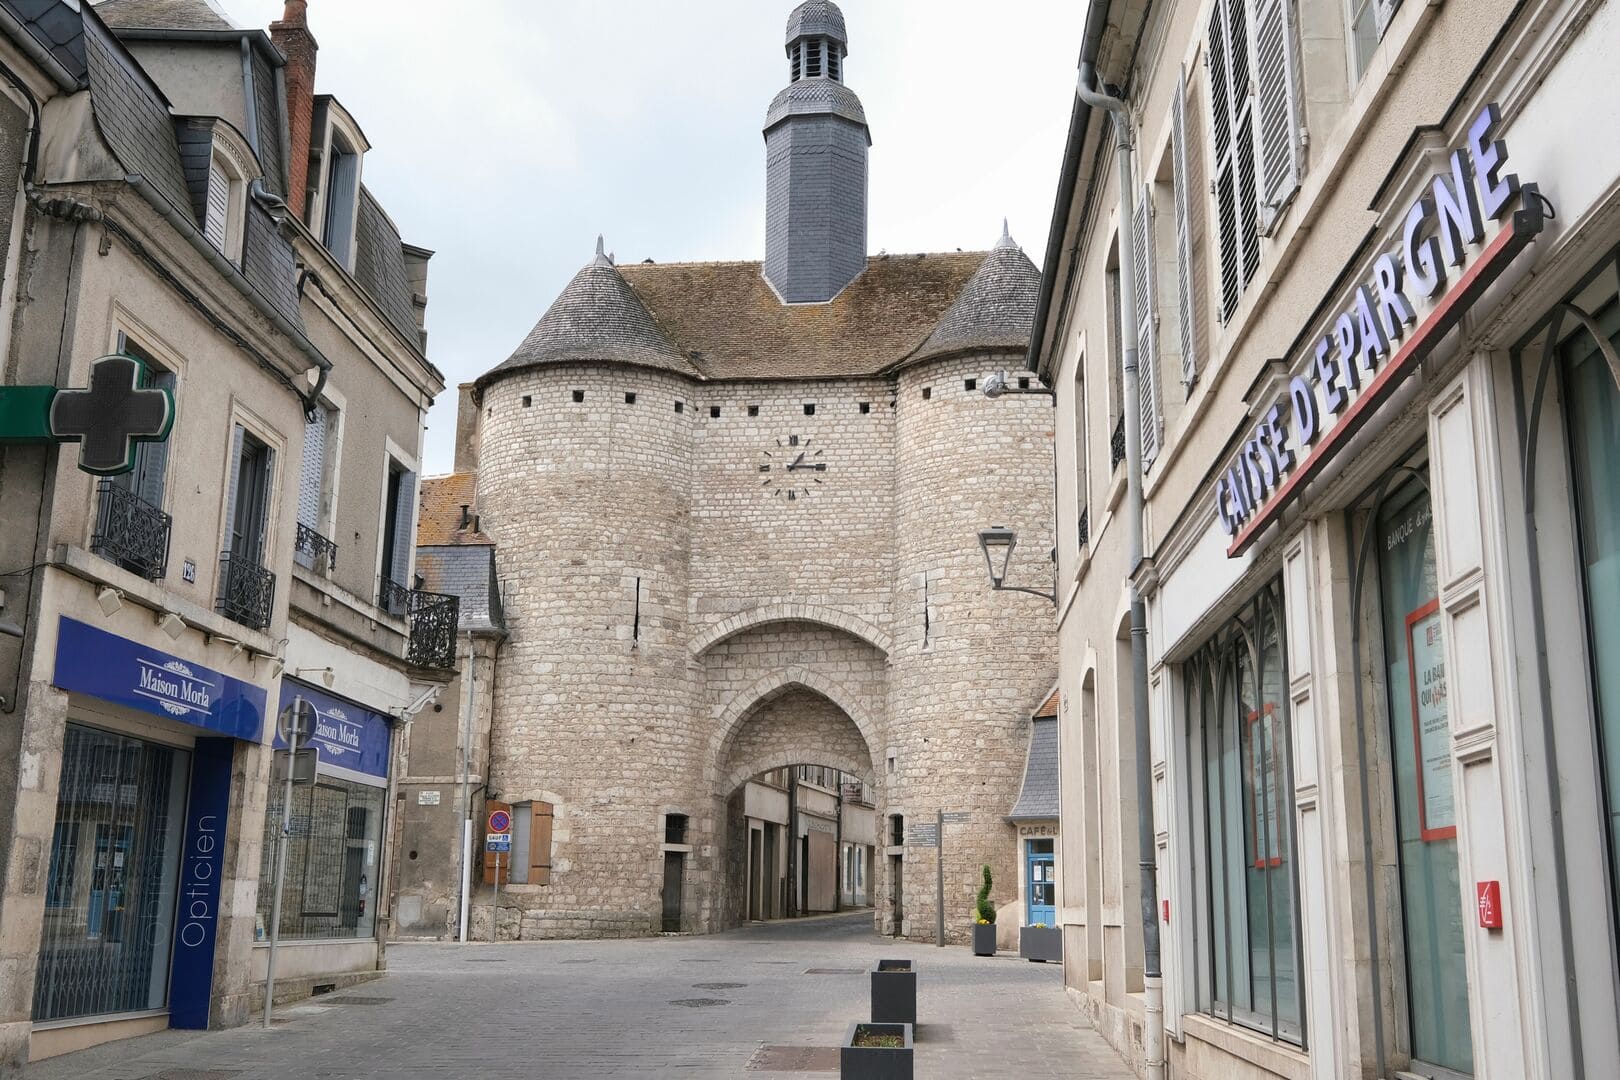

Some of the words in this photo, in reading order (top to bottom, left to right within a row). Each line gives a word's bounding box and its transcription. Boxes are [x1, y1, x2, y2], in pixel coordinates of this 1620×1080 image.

[1216, 403, 1294, 535] CAISSE
[1386, 517, 1414, 551] BANQUE
[139, 666, 178, 699] Maison
[180, 679, 210, 708] Morla
[1423, 669, 1432, 686] LA
[315, 718, 337, 740] aison
[339, 723, 360, 747] Morla
[181, 815, 217, 947] Opticien
